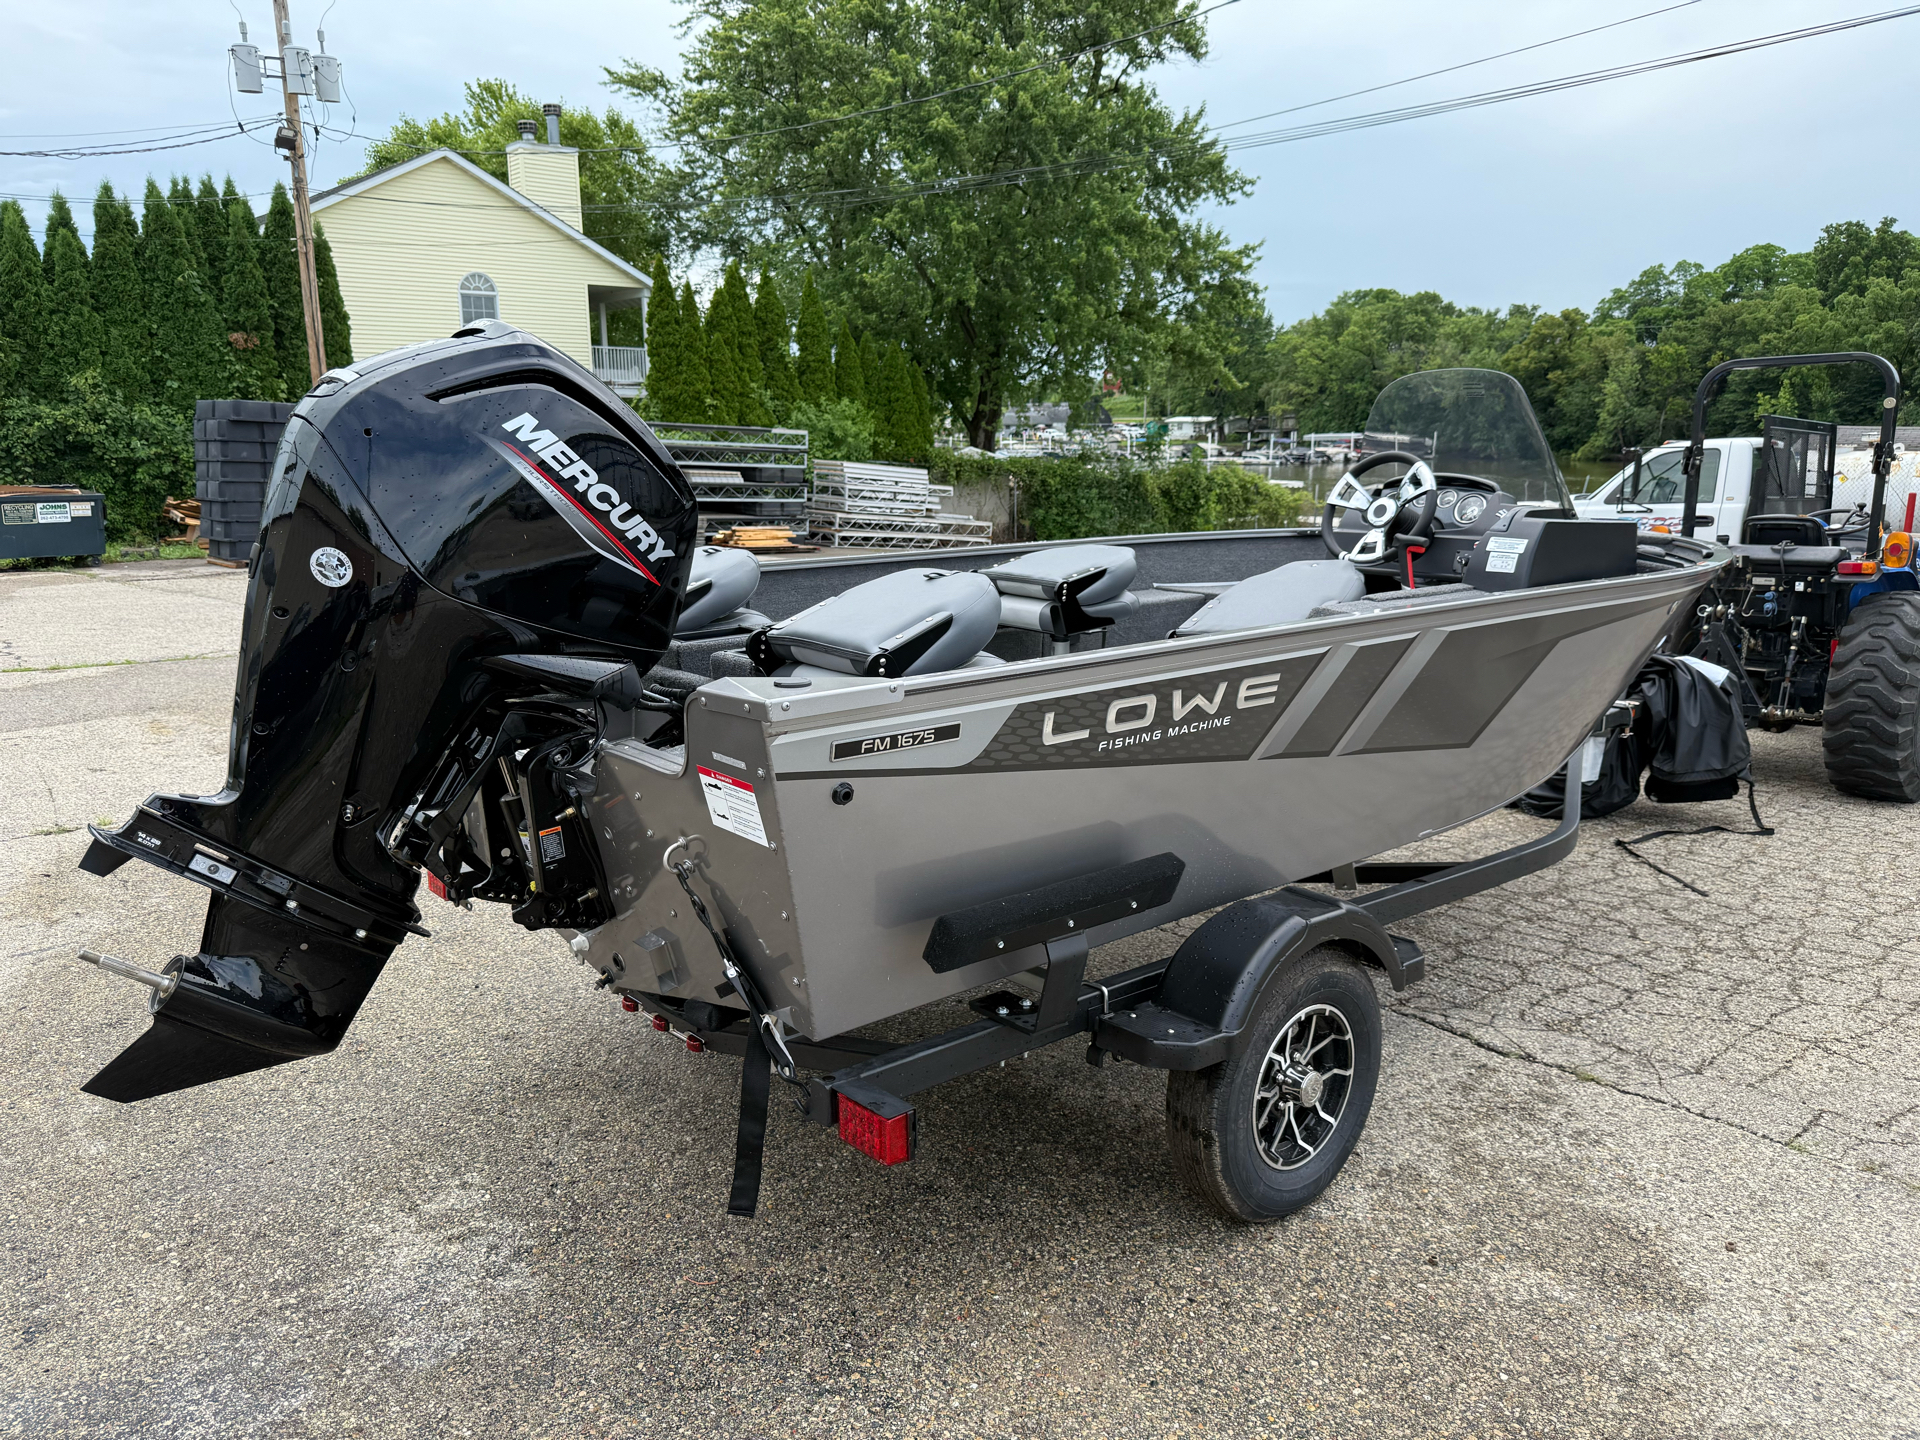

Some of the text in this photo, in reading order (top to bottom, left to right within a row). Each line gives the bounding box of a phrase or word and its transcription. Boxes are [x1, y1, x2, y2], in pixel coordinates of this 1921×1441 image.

[39, 503, 68, 511] JOHNS
[501, 412, 676, 563] MERCURY
[517, 460, 577, 515] FOURSTROKE
[1042, 673, 1281, 746] LOWE
[861, 729, 935, 754] FM 1675
[1098, 715, 1232, 752] FISHING MACHINE
